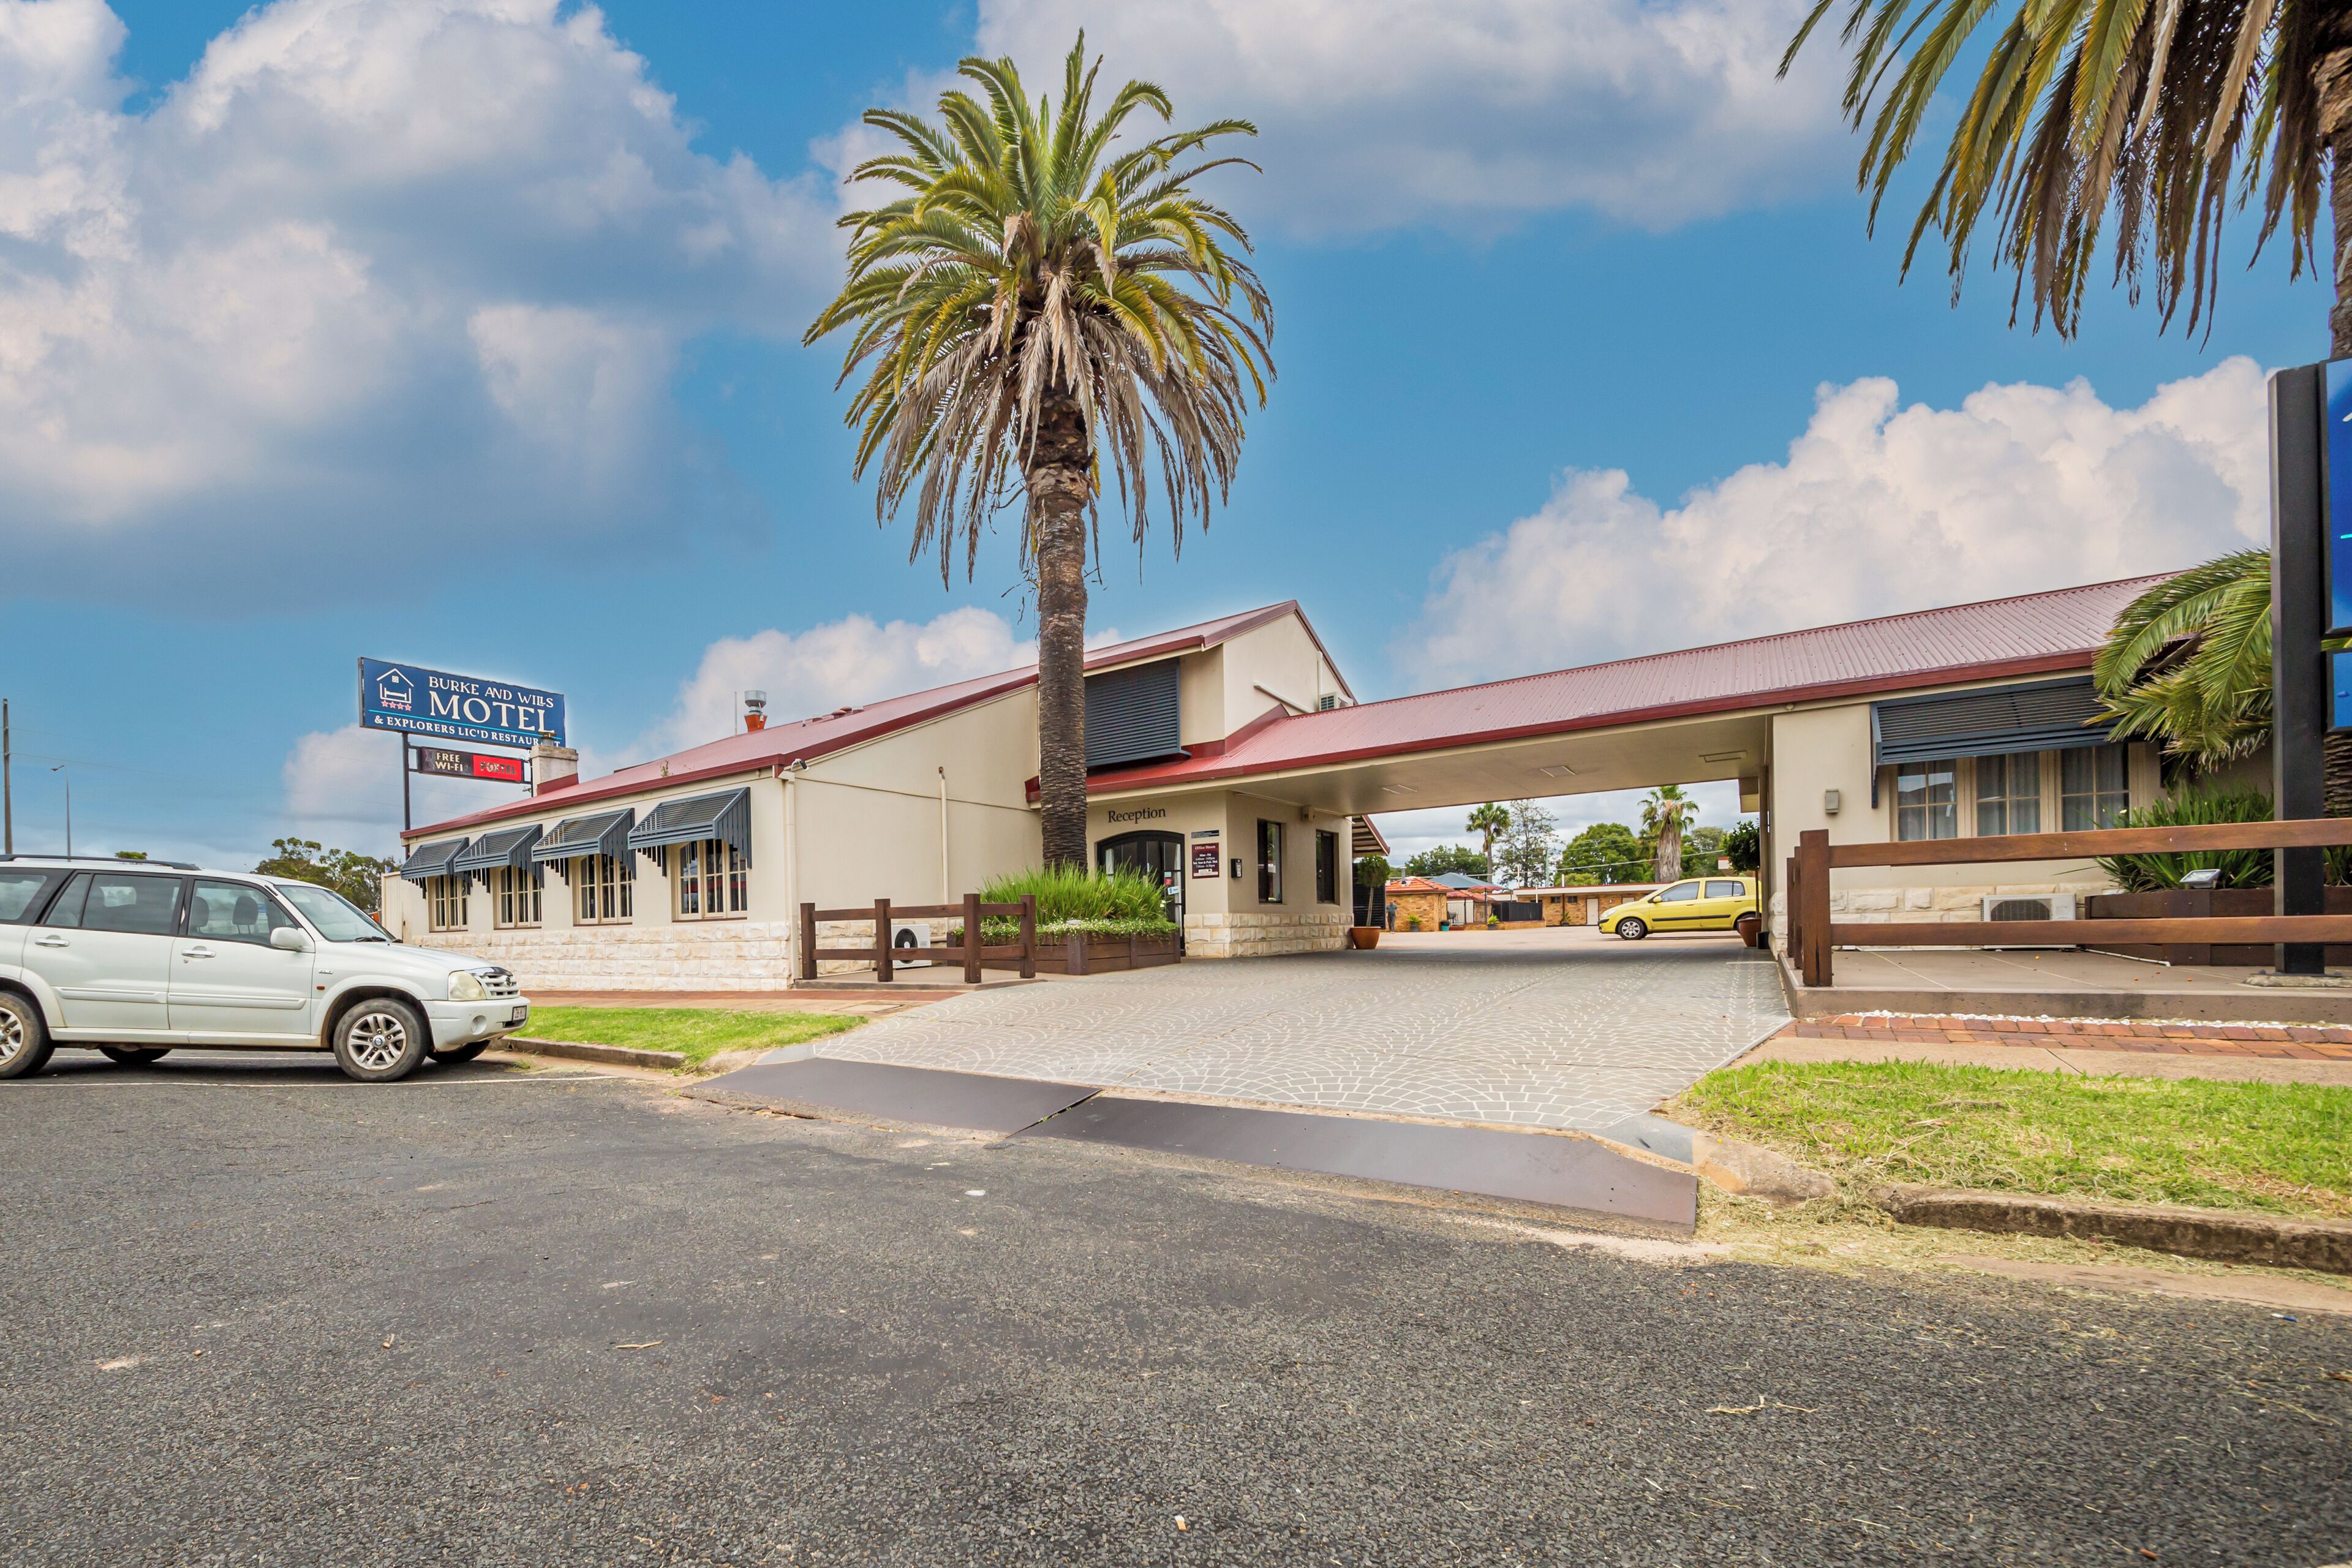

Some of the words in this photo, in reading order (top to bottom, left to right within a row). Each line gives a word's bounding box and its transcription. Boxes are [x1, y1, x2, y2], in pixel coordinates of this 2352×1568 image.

[429, 676, 480, 695] BURKE
[484, 687, 513, 701] AND
[517, 692, 554, 708] WILLS
[429, 690, 555, 733] MOTEL
[374, 715, 383, 725] &
[386, 716, 455, 734] EXPLORERS
[458, 727, 488, 739] LIC'D
[491, 732, 560, 747] RESTAURT
[436, 752, 460, 763] FREE
[435, 761, 463, 772] WI-FI
[480, 761, 516, 775] FOXTEL
[1108, 807, 1166, 824] Reception
